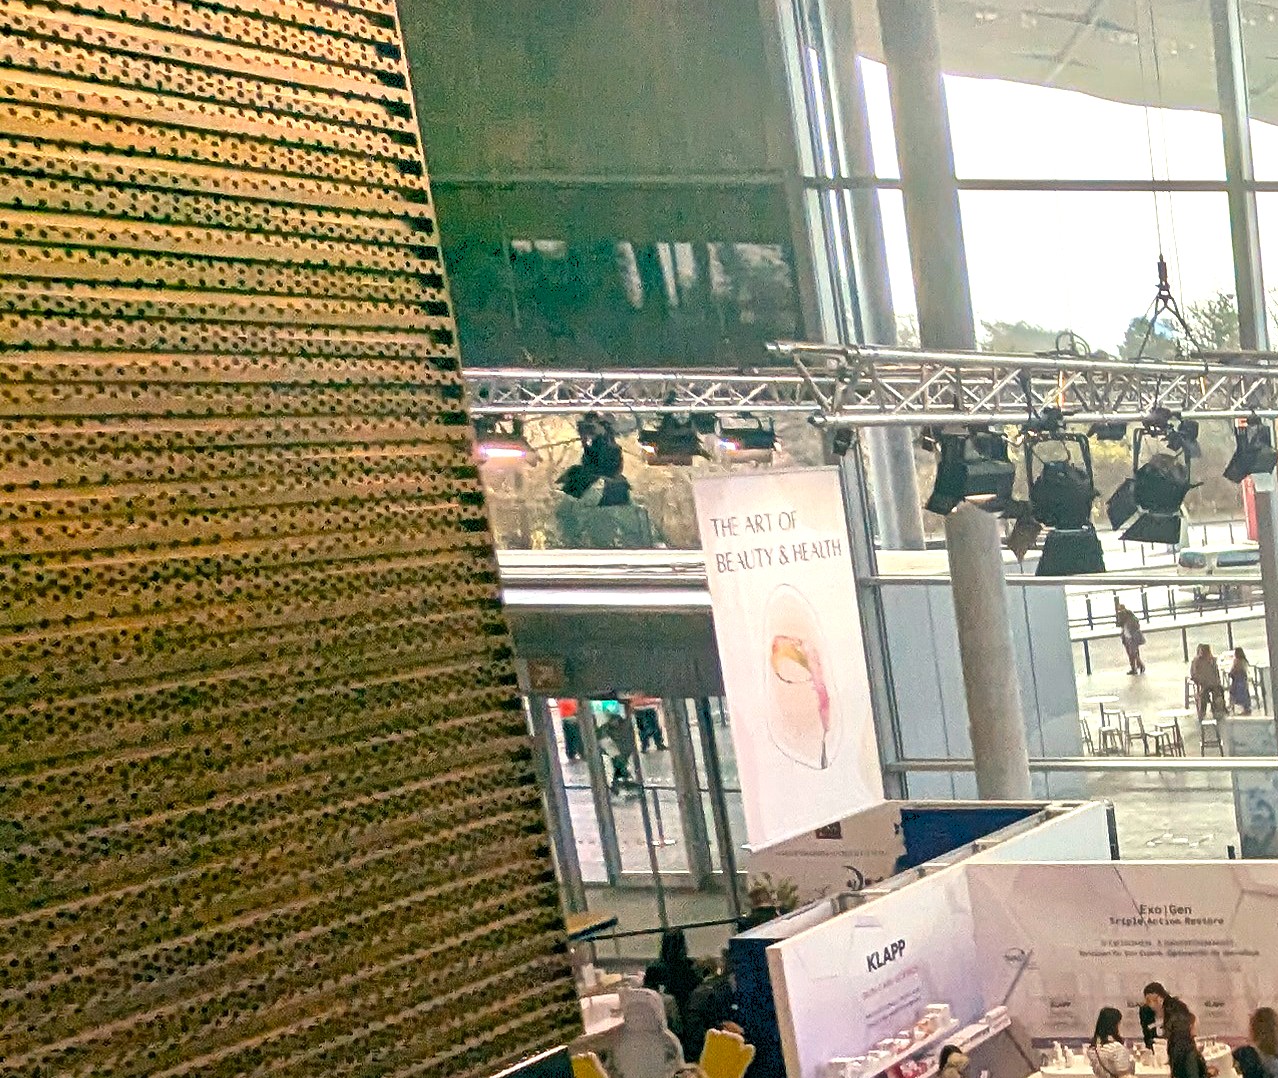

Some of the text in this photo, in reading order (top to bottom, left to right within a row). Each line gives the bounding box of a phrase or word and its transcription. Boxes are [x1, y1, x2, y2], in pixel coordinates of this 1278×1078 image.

[710, 510, 797, 537] THE ART OF
[716, 539, 842, 573] BEAUTY & HEALTH
[866, 939, 906, 972] KLAPP
